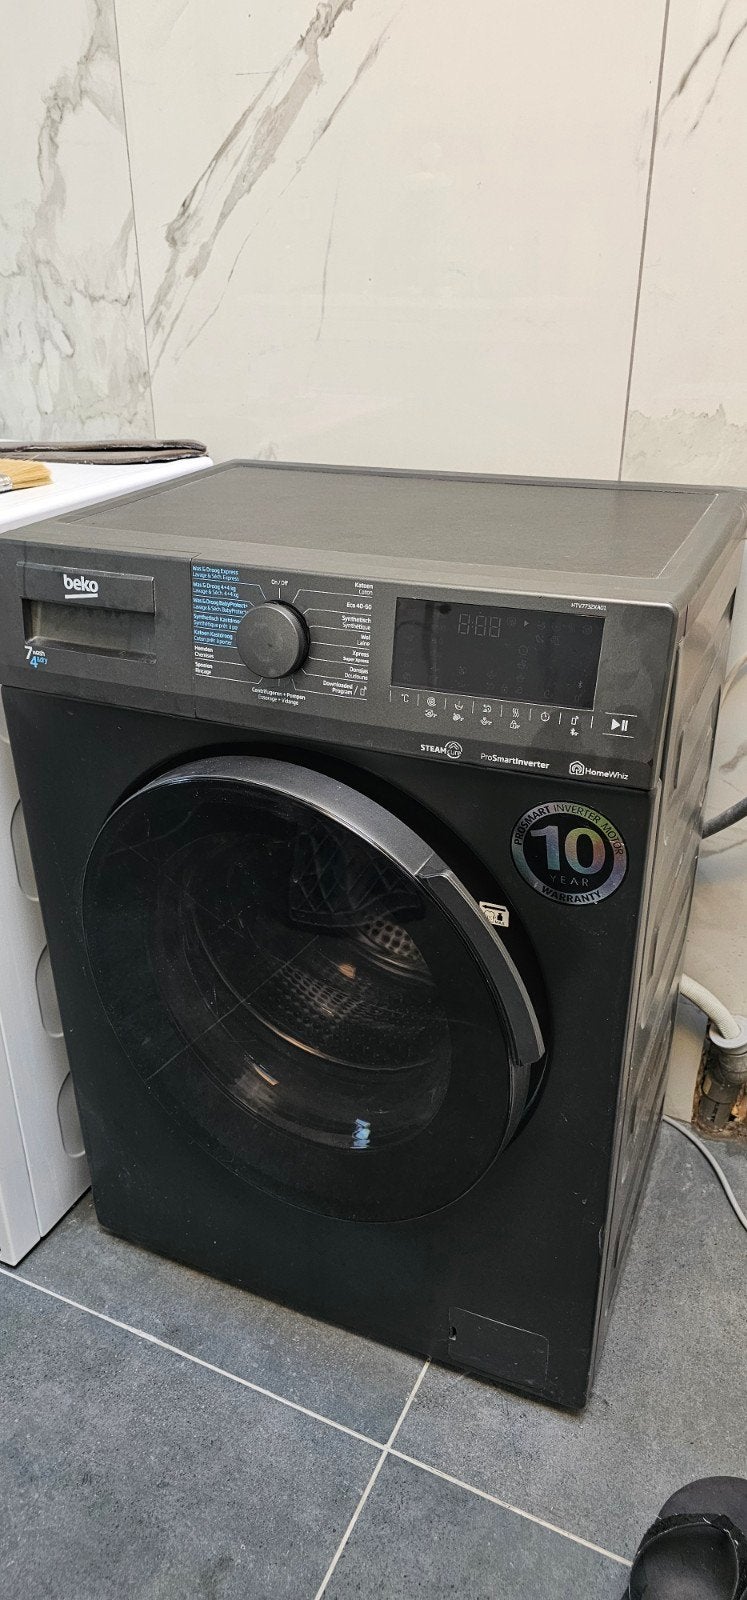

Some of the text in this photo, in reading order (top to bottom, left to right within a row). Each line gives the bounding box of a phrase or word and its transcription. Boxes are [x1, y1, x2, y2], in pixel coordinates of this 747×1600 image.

[63, 574, 98, 593] beko
[355, 582, 373, 590] Katoen
[24, 645, 32, 660] 7
[352, 650, 369, 658] Xpress
[323, 680, 353, 689] Downloaded
[332, 687, 352, 695] Program
[480, 753, 550, 769] ProSmartInverter
[585, 767, 629, 780] HomeWhiz
[514, 804, 624, 855] PROSMART INVERTER MOTOR
[530, 825, 606, 875] 10
[550, 875, 589, 887] YEAR
[542, 886, 601, 903] WARRANTY
